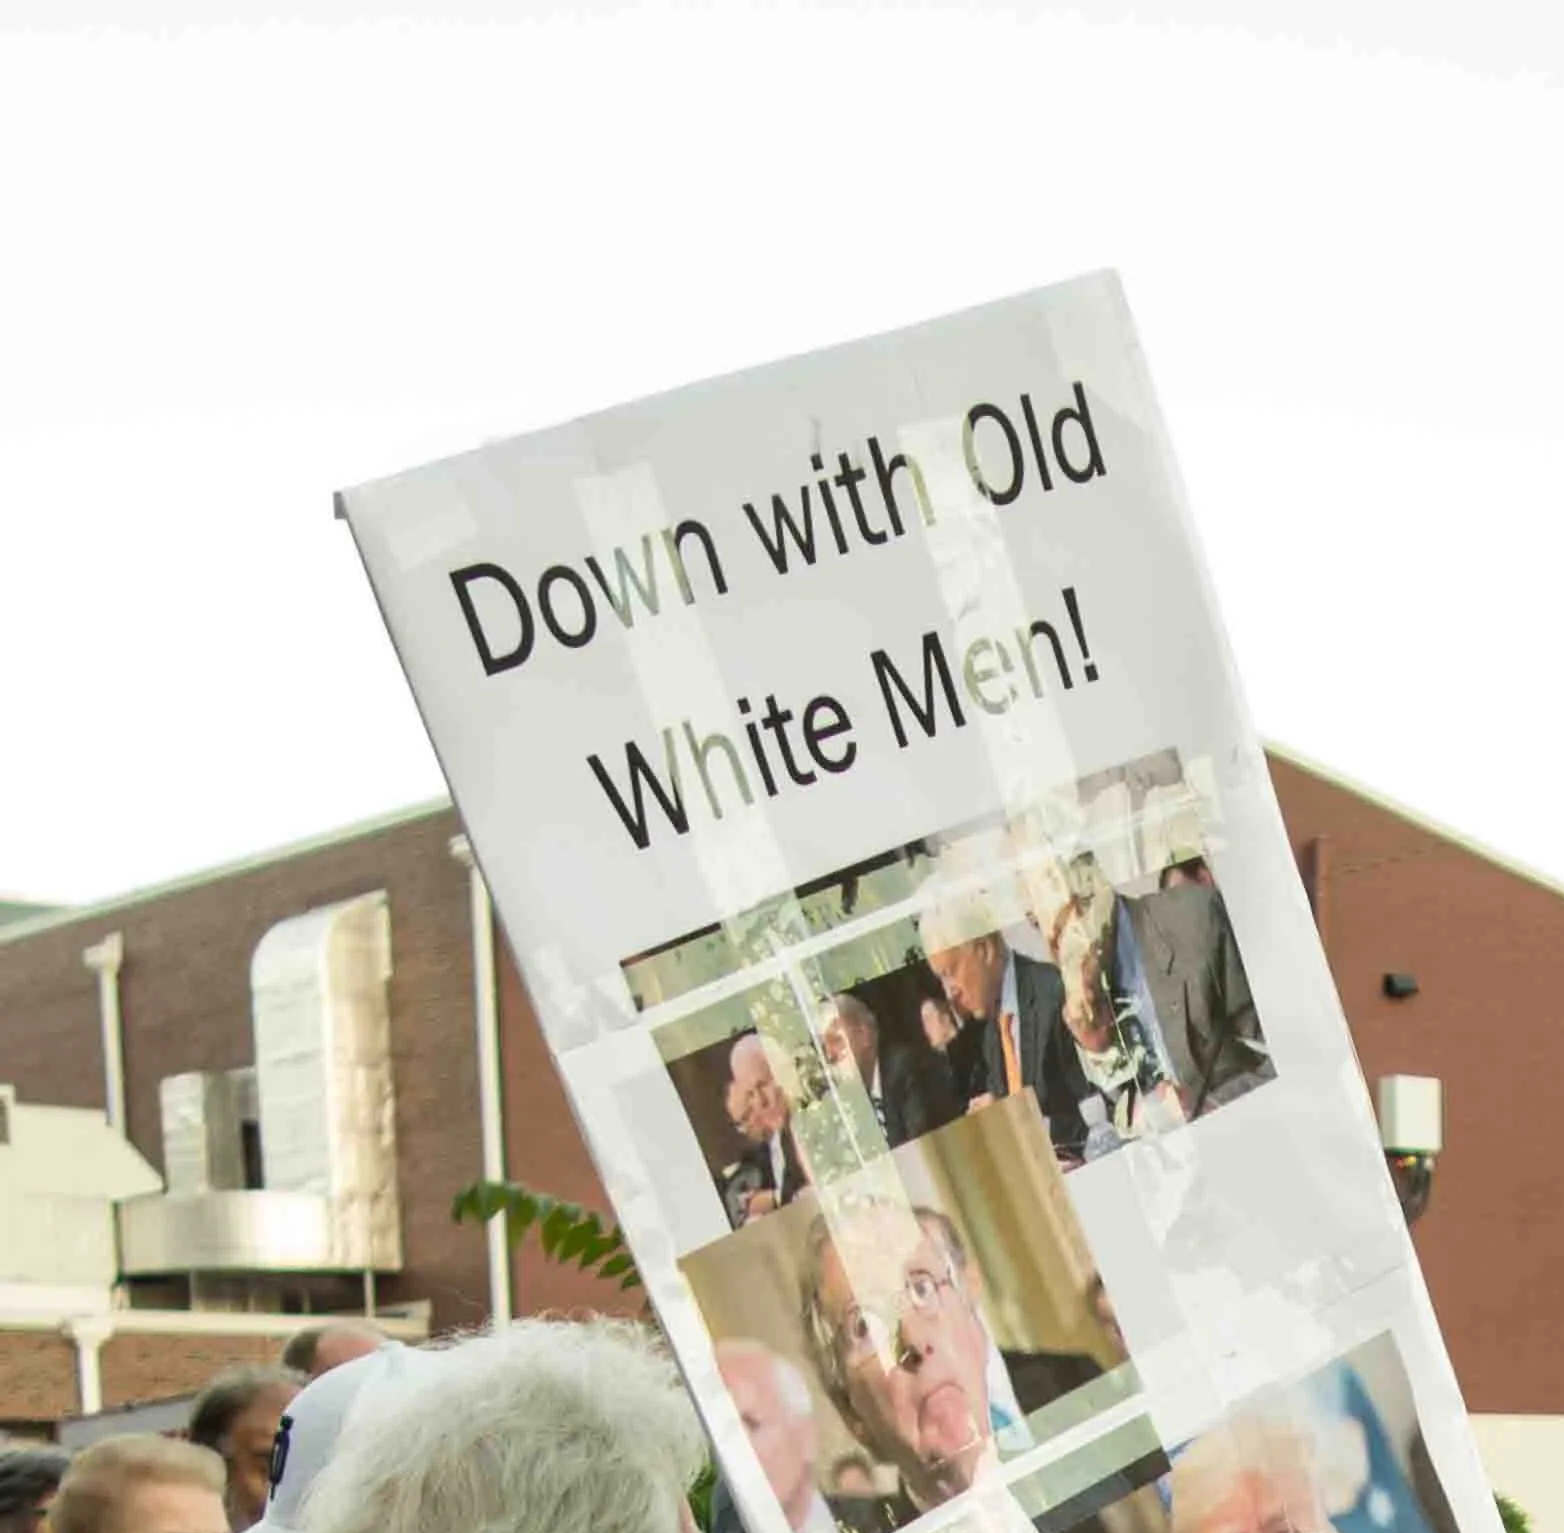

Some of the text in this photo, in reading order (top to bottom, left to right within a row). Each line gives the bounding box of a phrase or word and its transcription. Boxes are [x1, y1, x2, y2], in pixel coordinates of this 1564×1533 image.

[447, 380, 1107, 678] Down with Old
[587, 585, 1101, 851] White Men!
